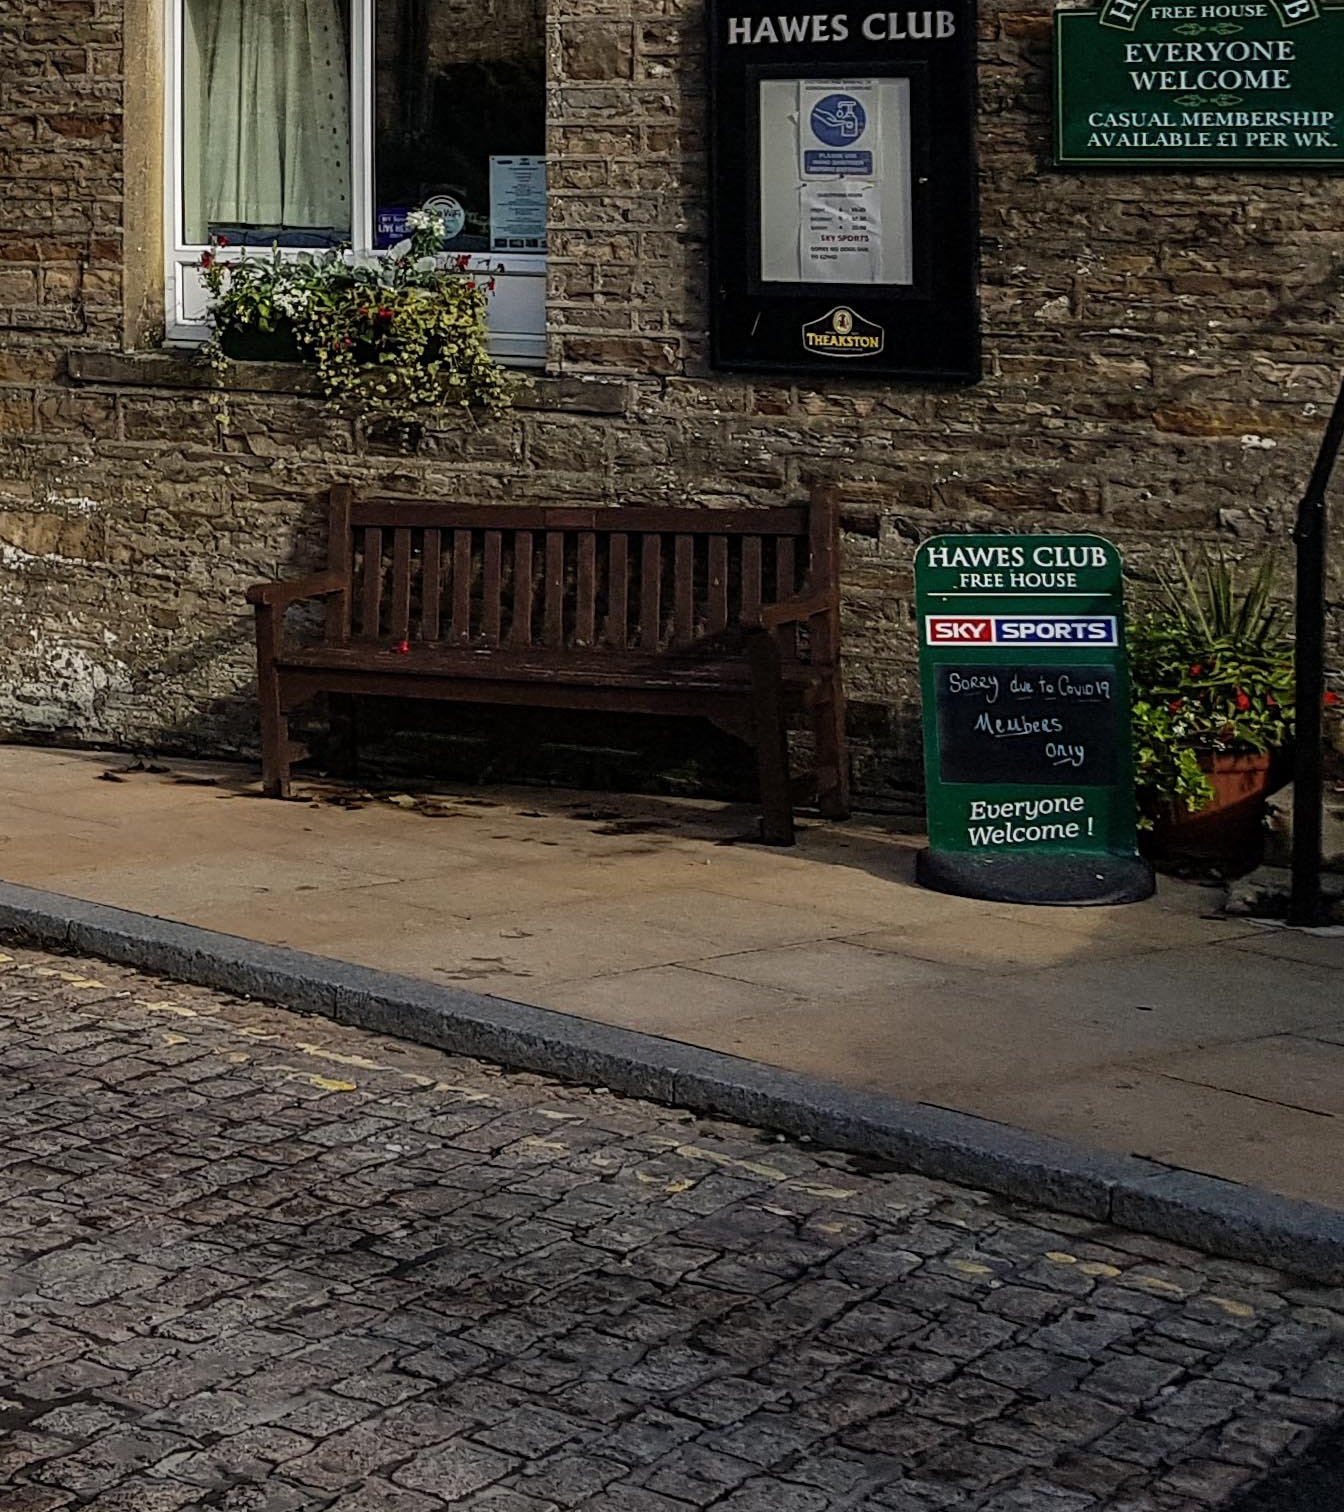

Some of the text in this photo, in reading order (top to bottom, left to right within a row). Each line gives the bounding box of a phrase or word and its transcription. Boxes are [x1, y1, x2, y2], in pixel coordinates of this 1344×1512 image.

[1151, 4, 1268, 19] FREE HOUSE
[727, 10, 956, 44] HAWES CLUB
[1123, 41, 1296, 63] EVERYONE
[1129, 69, 1291, 90] WELCOME
[1088, 111, 1334, 127] CASUAL MEMBERSHIP
[1087, 132, 1212, 147] AVAILABLE
[1217, 133, 1238, 147] £1
[1245, 133, 1288, 147] PER
[806, 332, 879, 348] THEAKSTON
[927, 546, 1108, 568] HAWES CLUB
[960, 572, 1077, 588] FREE HOUSE
[934, 622, 1106, 639] SKY SPORTS
[1010, 674, 1033, 693] due
[1038, 675, 1054, 693] to
[969, 796, 1084, 822] Everyone
